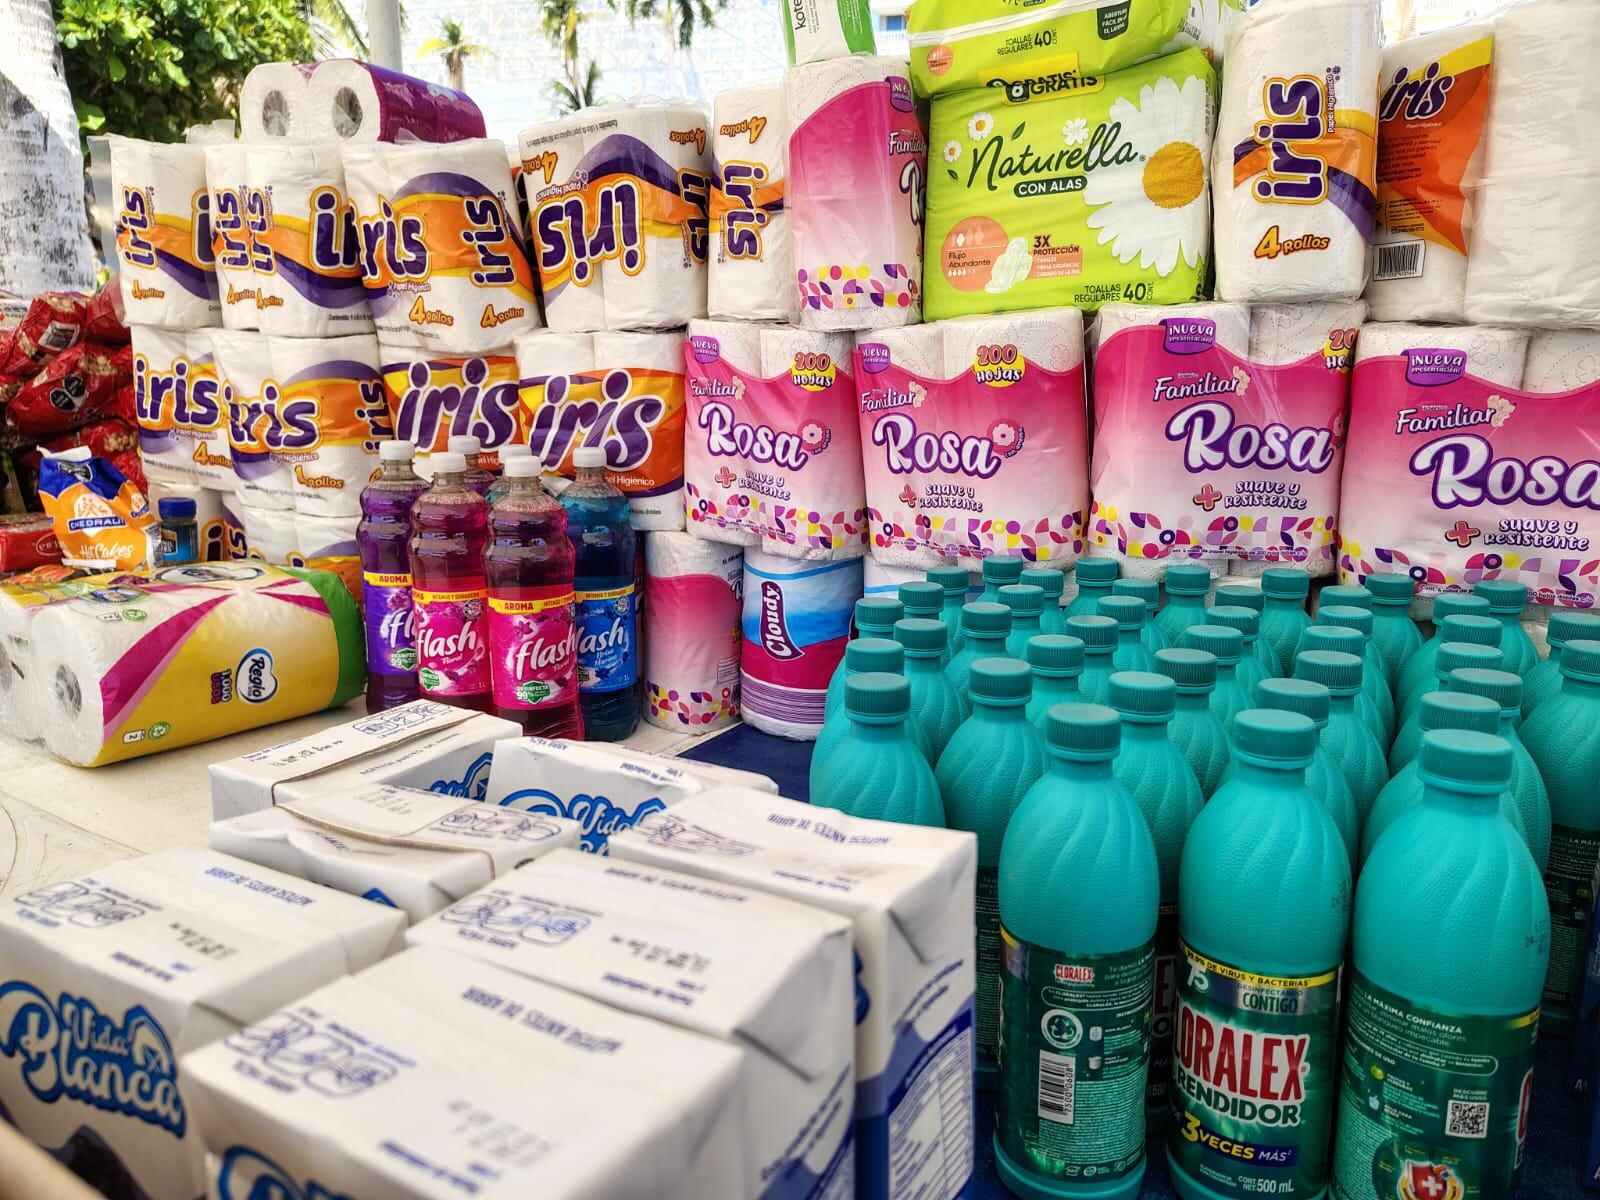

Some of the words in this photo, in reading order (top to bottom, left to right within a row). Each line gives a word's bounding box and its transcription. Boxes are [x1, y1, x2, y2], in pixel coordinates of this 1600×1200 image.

[793, 0, 807, 30] kote
[997, 42, 1034, 56] REGULARES
[1034, 30, 1052, 48] 40
[1325, 74, 1336, 111] Higiénico
[1379, 62, 1453, 122] iris
[749, 117, 767, 143] 4
[1326, 111, 1336, 134] Papel
[696, 128, 706, 155] 4
[1256, 80, 1325, 200] iris
[541, 152, 558, 184] 4
[967, 121, 1139, 191] Naturella
[1018, 182, 1050, 197] CON
[1050, 178, 1083, 193] ALAS
[723, 164, 766, 257] iris
[124, 189, 156, 267] iris
[215, 190, 249, 267] iris
[463, 199, 515, 283] iris
[538, 181, 639, 281] iris
[1033, 235, 1051, 249] 3X
[1033, 245, 1080, 256] PROTECCIÓN
[1255, 225, 1283, 259] 4
[1282, 233, 1330, 255] Rollos
[948, 258, 991, 269] Abundante
[1074, 292, 1121, 303] REGULARES
[1085, 284, 1121, 294] TOALLAS
[1123, 283, 1147, 301] 40
[409, 296, 426, 324] 4
[425, 310, 454, 325] Rollos
[481, 304, 497, 328] 4
[496, 308, 524, 324] Rollos
[794, 352, 831, 371] 200
[977, 345, 1017, 366] 200
[1411, 353, 1464, 367] ¡Nueva
[793, 374, 833, 388] Hojas
[976, 368, 1021, 384] Hojas
[1153, 373, 1239, 402] Familiar
[136, 359, 220, 426] iris
[397, 358, 520, 452] iris
[860, 387, 915, 413] Familiar
[529, 370, 665, 472] iris
[1395, 403, 1496, 435] Familiar
[699, 401, 808, 472] Rosa
[872, 412, 1002, 480] Rosa
[1165, 400, 1334, 474] Rosa
[193, 442, 208, 465] 4
[306, 475, 345, 489] Rollos
[616, 475, 655, 487] Higiénico
[1409, 432, 1600, 511] Rosa
[925, 484, 965, 498] suave
[967, 487, 975, 498] y
[1236, 480, 1284, 494] suave
[1288, 482, 1300, 495] y
[1499, 518, 1560, 533] suave
[1564, 520, 1578, 535] y
[379, 575, 408, 583] AROMA
[504, 602, 534, 611] AROMA
[765, 585, 788, 658] Cloudy
[417, 620, 478, 665] flash
[576, 617, 626, 654] lash
[515, 622, 577, 681] flash
[249, 656, 266, 698] Regio
[1055, 964, 1093, 982] CLORALEX
[1207, 961, 1218, 971] DE
[1220, 966, 1247, 981] VIRUS
[1249, 975, 1256, 983] Y
[1257, 977, 1309, 988] BACTERIAS
[1237, 983, 1303, 997] DESINFECTANDO
[1242, 992, 1299, 1014] CONTIGO
[62, 993, 130, 1056] Vida
[1365, 991, 1373, 1002] LA
[1373, 996, 1405, 1019] MÁXIMA
[1406, 1012, 1463, 1035] CONFIANZA
[1405, 1027, 1450, 1046] impecable
[1411, 1023, 1437, 1038] malos
[1440, 1030, 1467, 1042] olores
[1176, 1071, 1300, 1127] RENDIDOR
[1181, 1110, 1201, 1144] 3
[1199, 1129, 1256, 1161] VECES
[1256, 1178, 1278, 1194] 500
[1278, 1178, 1295, 1193] mL
